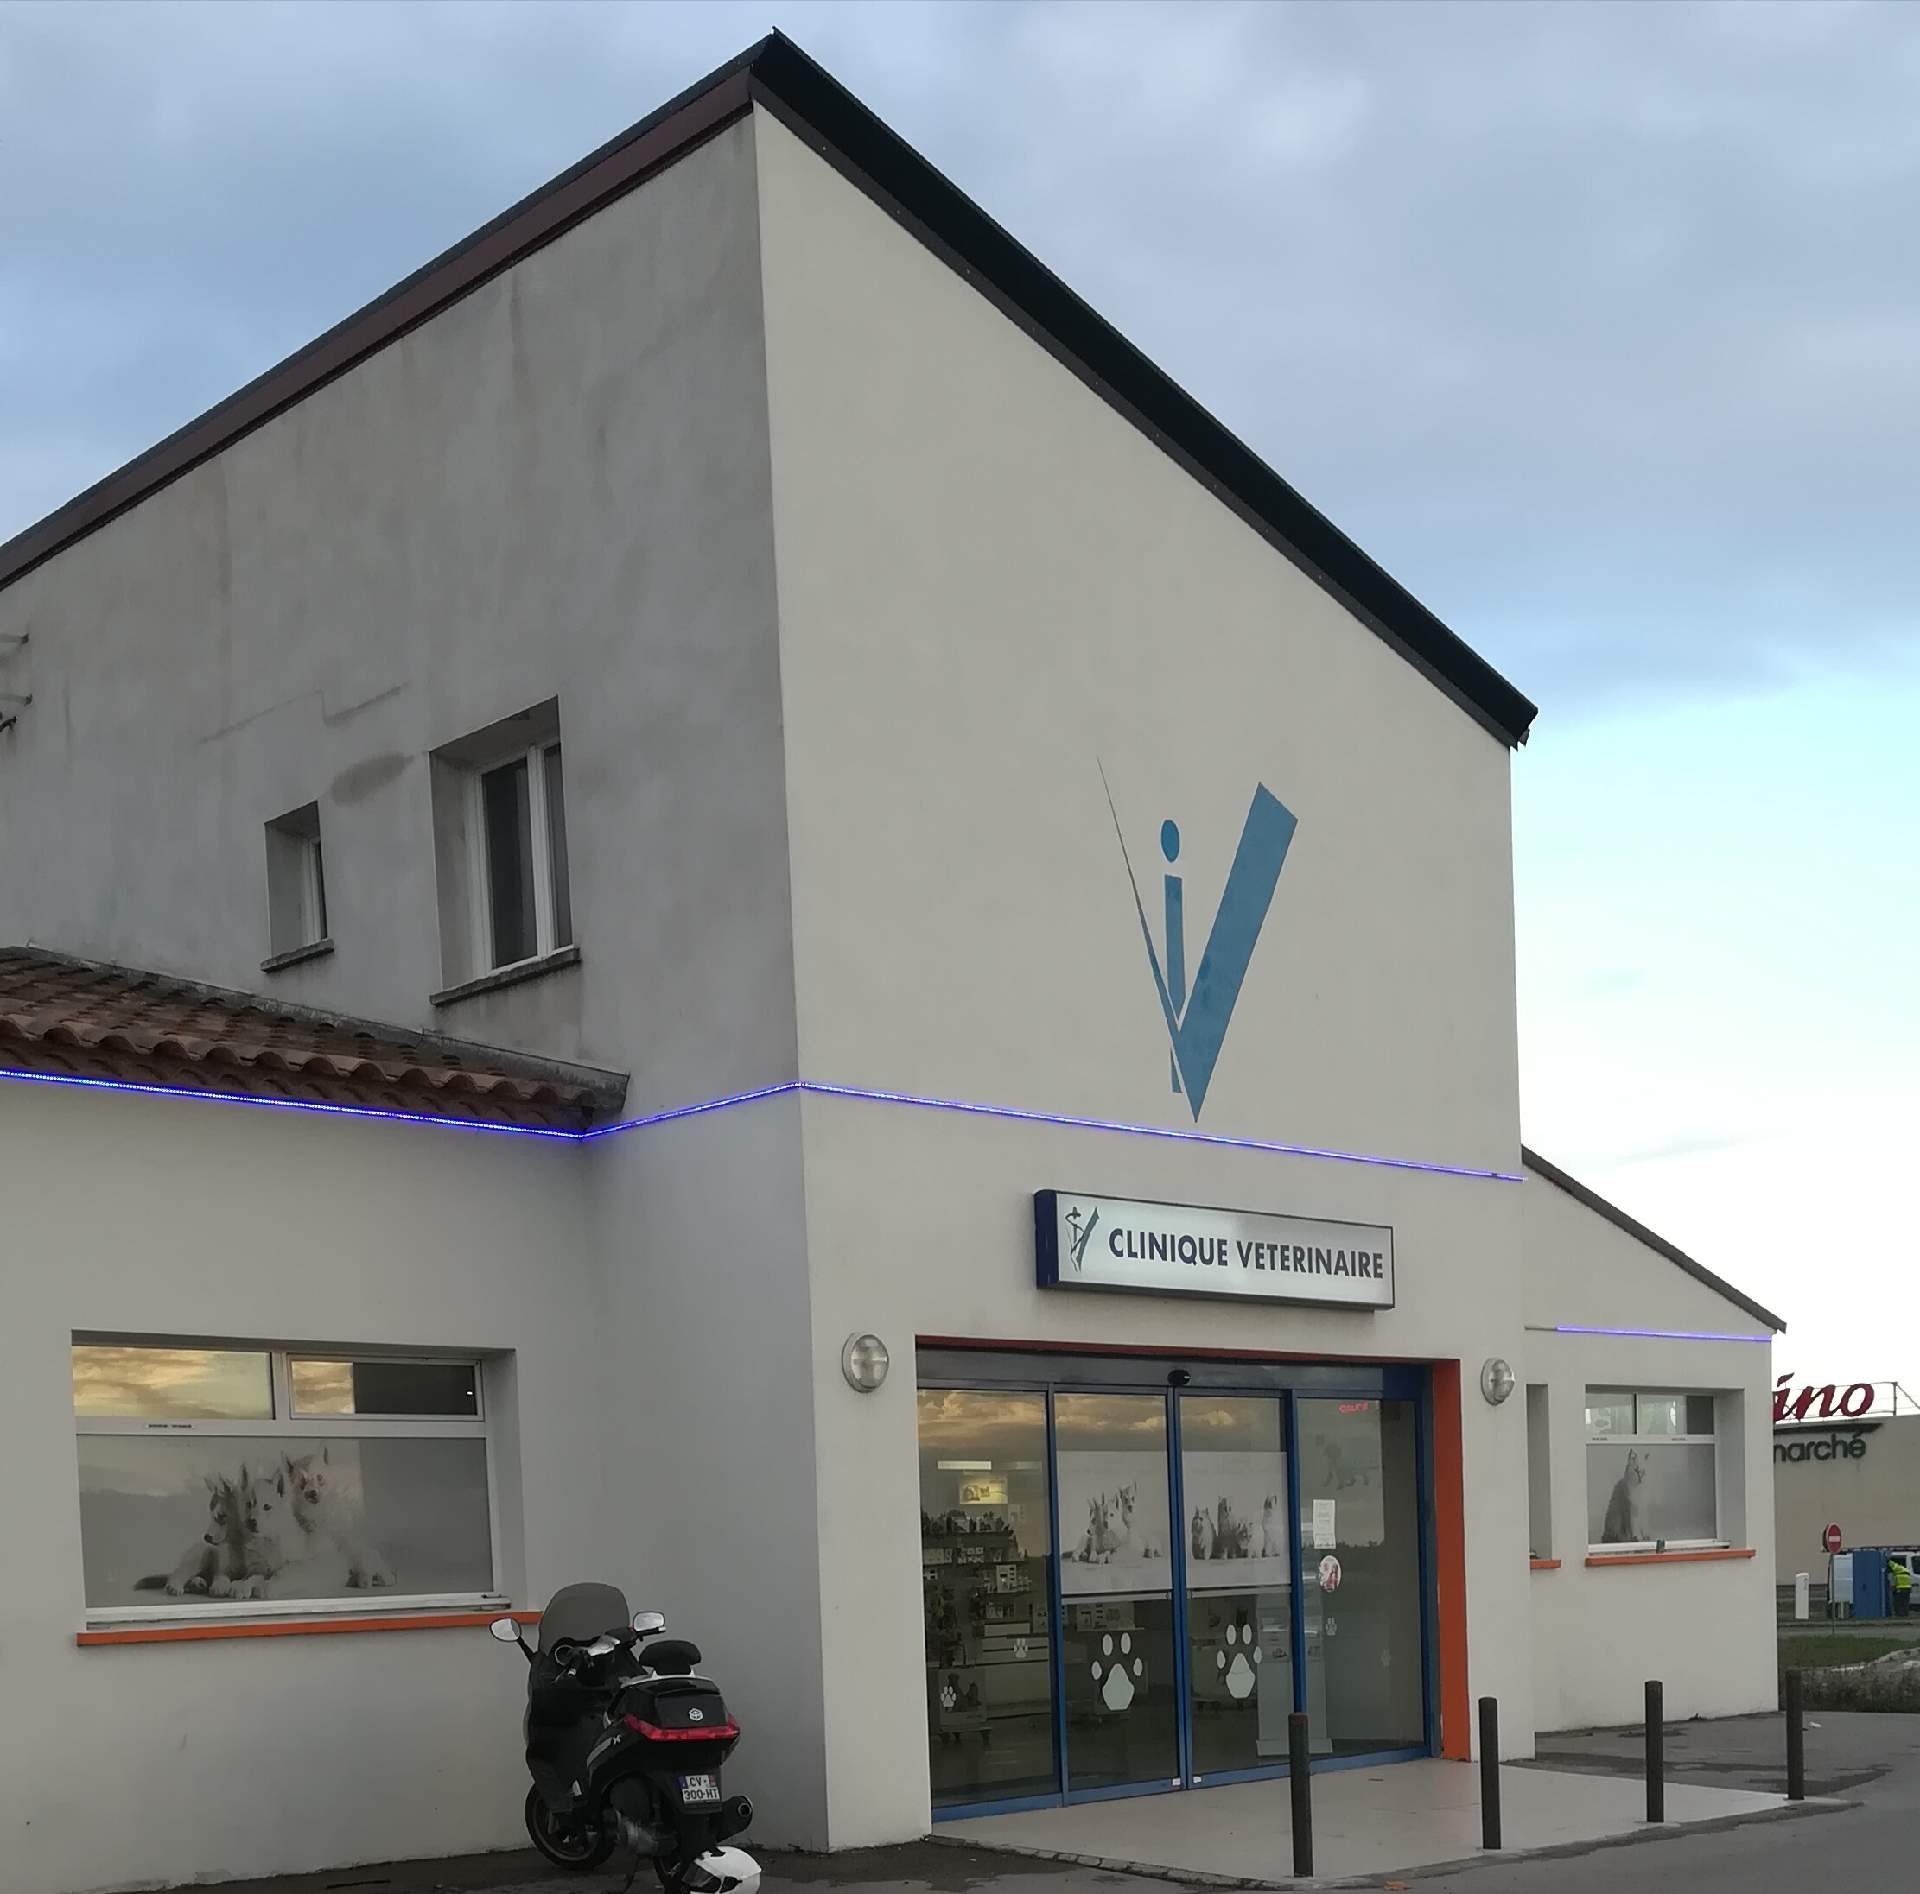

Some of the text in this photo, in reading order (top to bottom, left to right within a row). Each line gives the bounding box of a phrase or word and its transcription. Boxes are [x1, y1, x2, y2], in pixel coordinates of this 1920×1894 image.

[1108, 1227, 1384, 1279] CLINIQUE VETERINAIRE
[1773, 1372, 1875, 1422] ino
